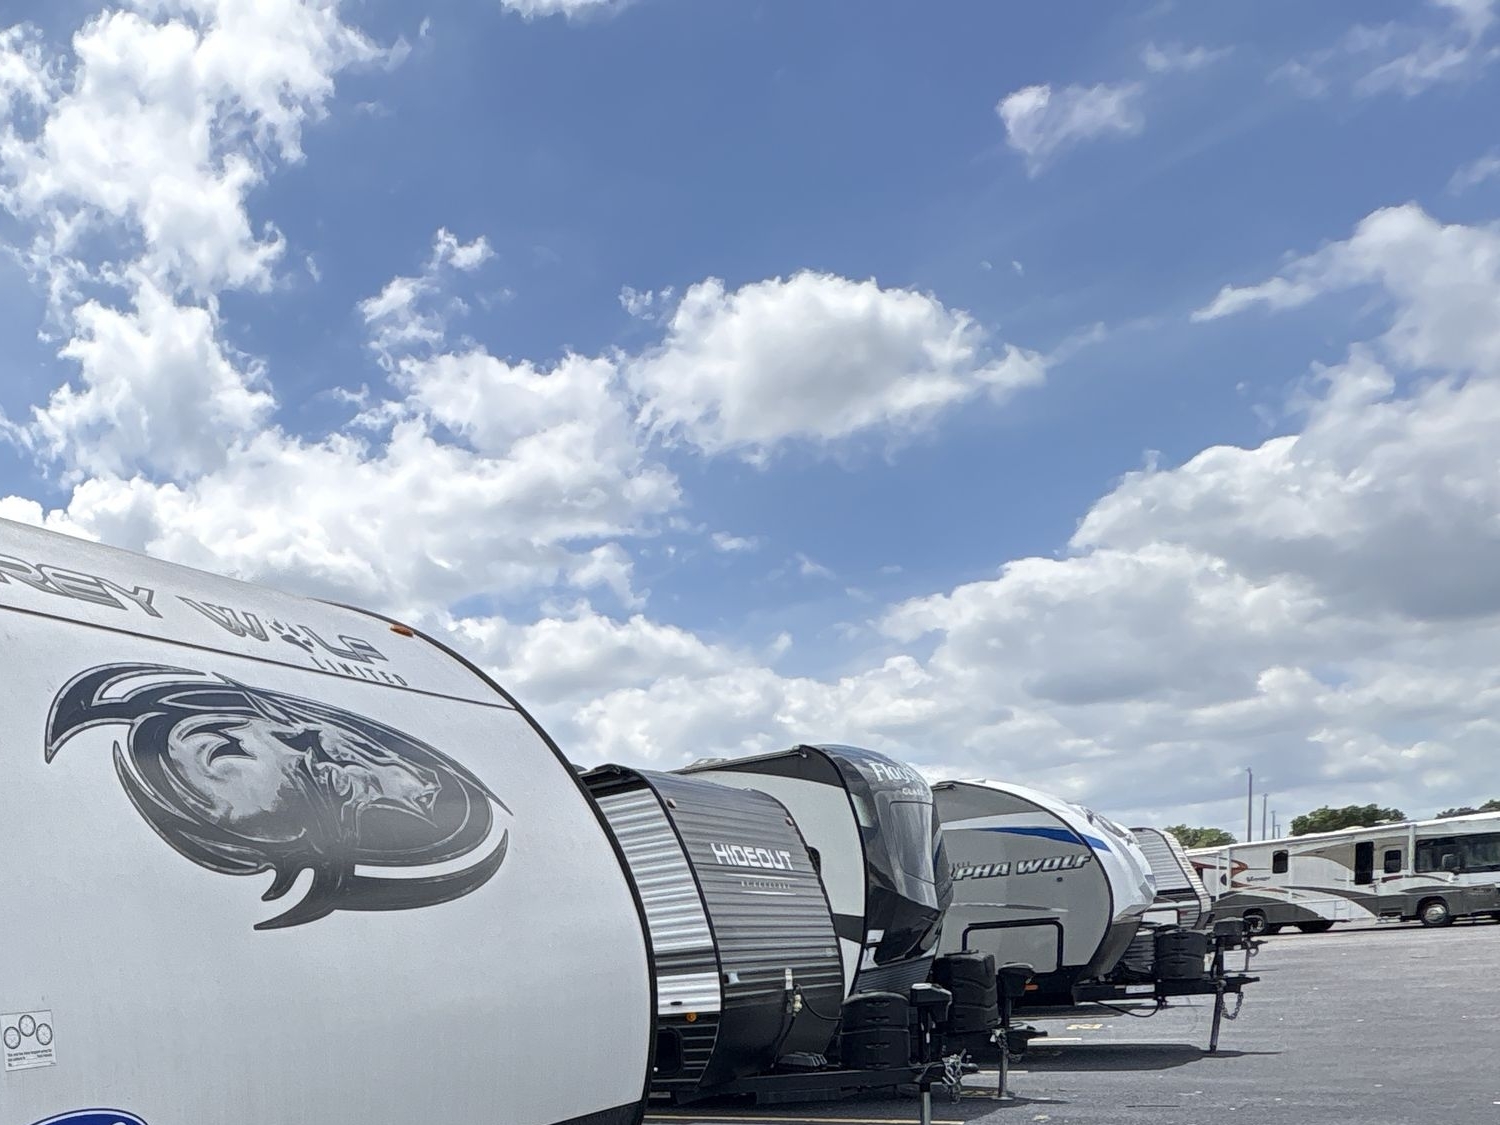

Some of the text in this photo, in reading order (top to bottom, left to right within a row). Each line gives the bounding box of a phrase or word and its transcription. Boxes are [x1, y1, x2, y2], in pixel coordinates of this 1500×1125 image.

[310, 656, 408, 687] LIMITED
[709, 843, 794, 871] HIDEOUT
[1016, 854, 1093, 875] WOLF
